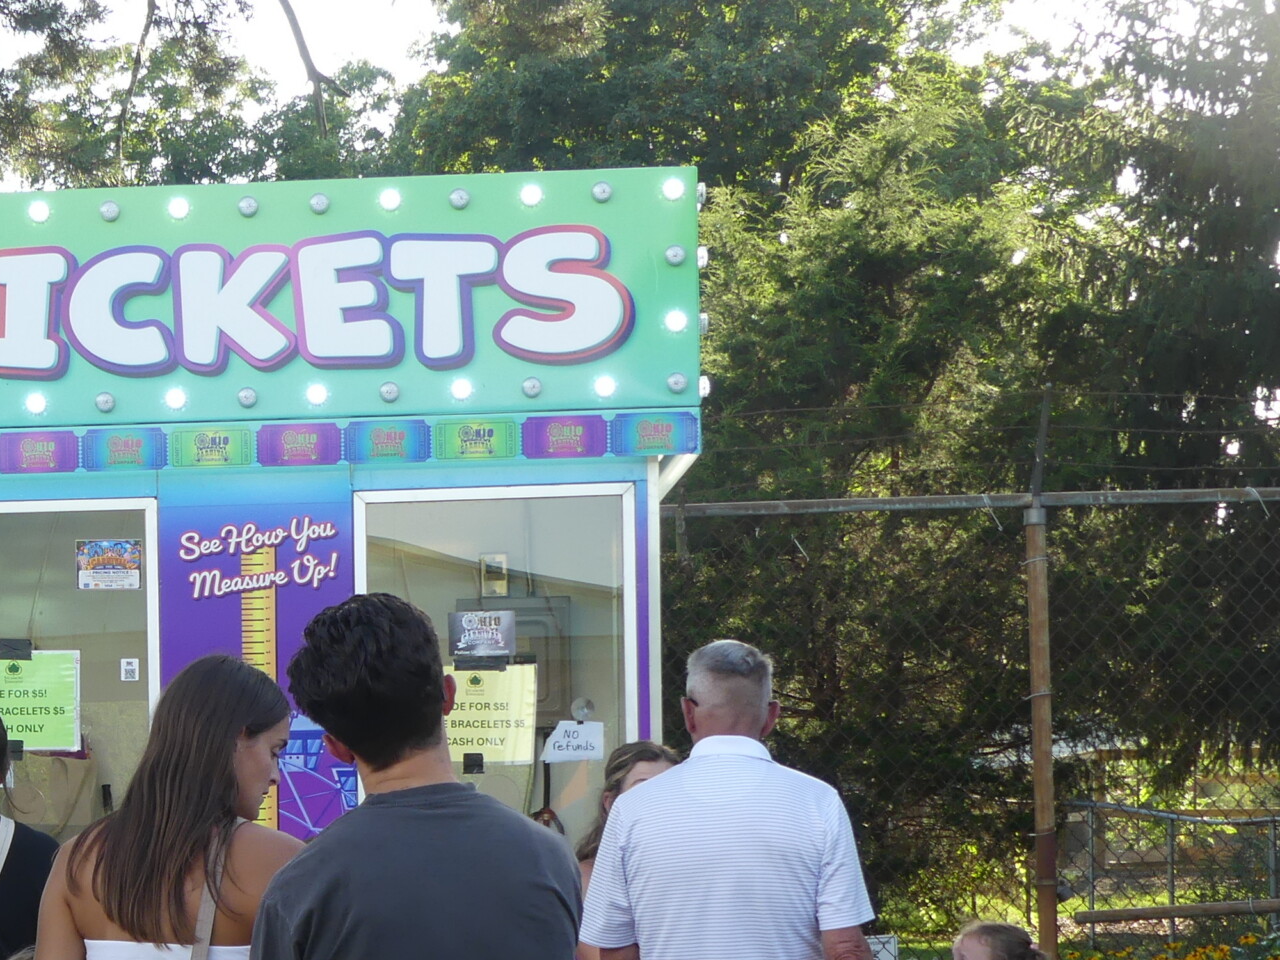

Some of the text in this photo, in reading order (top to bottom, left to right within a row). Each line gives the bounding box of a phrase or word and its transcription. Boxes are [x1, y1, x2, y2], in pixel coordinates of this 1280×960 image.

[179, 515, 337, 561] See How You
[188, 552, 339, 600] Measure Up!
[8, 690, 29, 699] FOR
[32, 689, 47, 699] $5!
[53, 706, 65, 716] $5
[454, 701, 509, 711] DE FOR $5!
[16, 724, 45, 734] ONLY
[451, 719, 511, 729] BRACELETS
[513, 719, 525, 730] $5
[563, 729, 580, 740] NO
[447, 736, 506, 746] CASH ONLY
[552, 740, 596, 752] refunds
